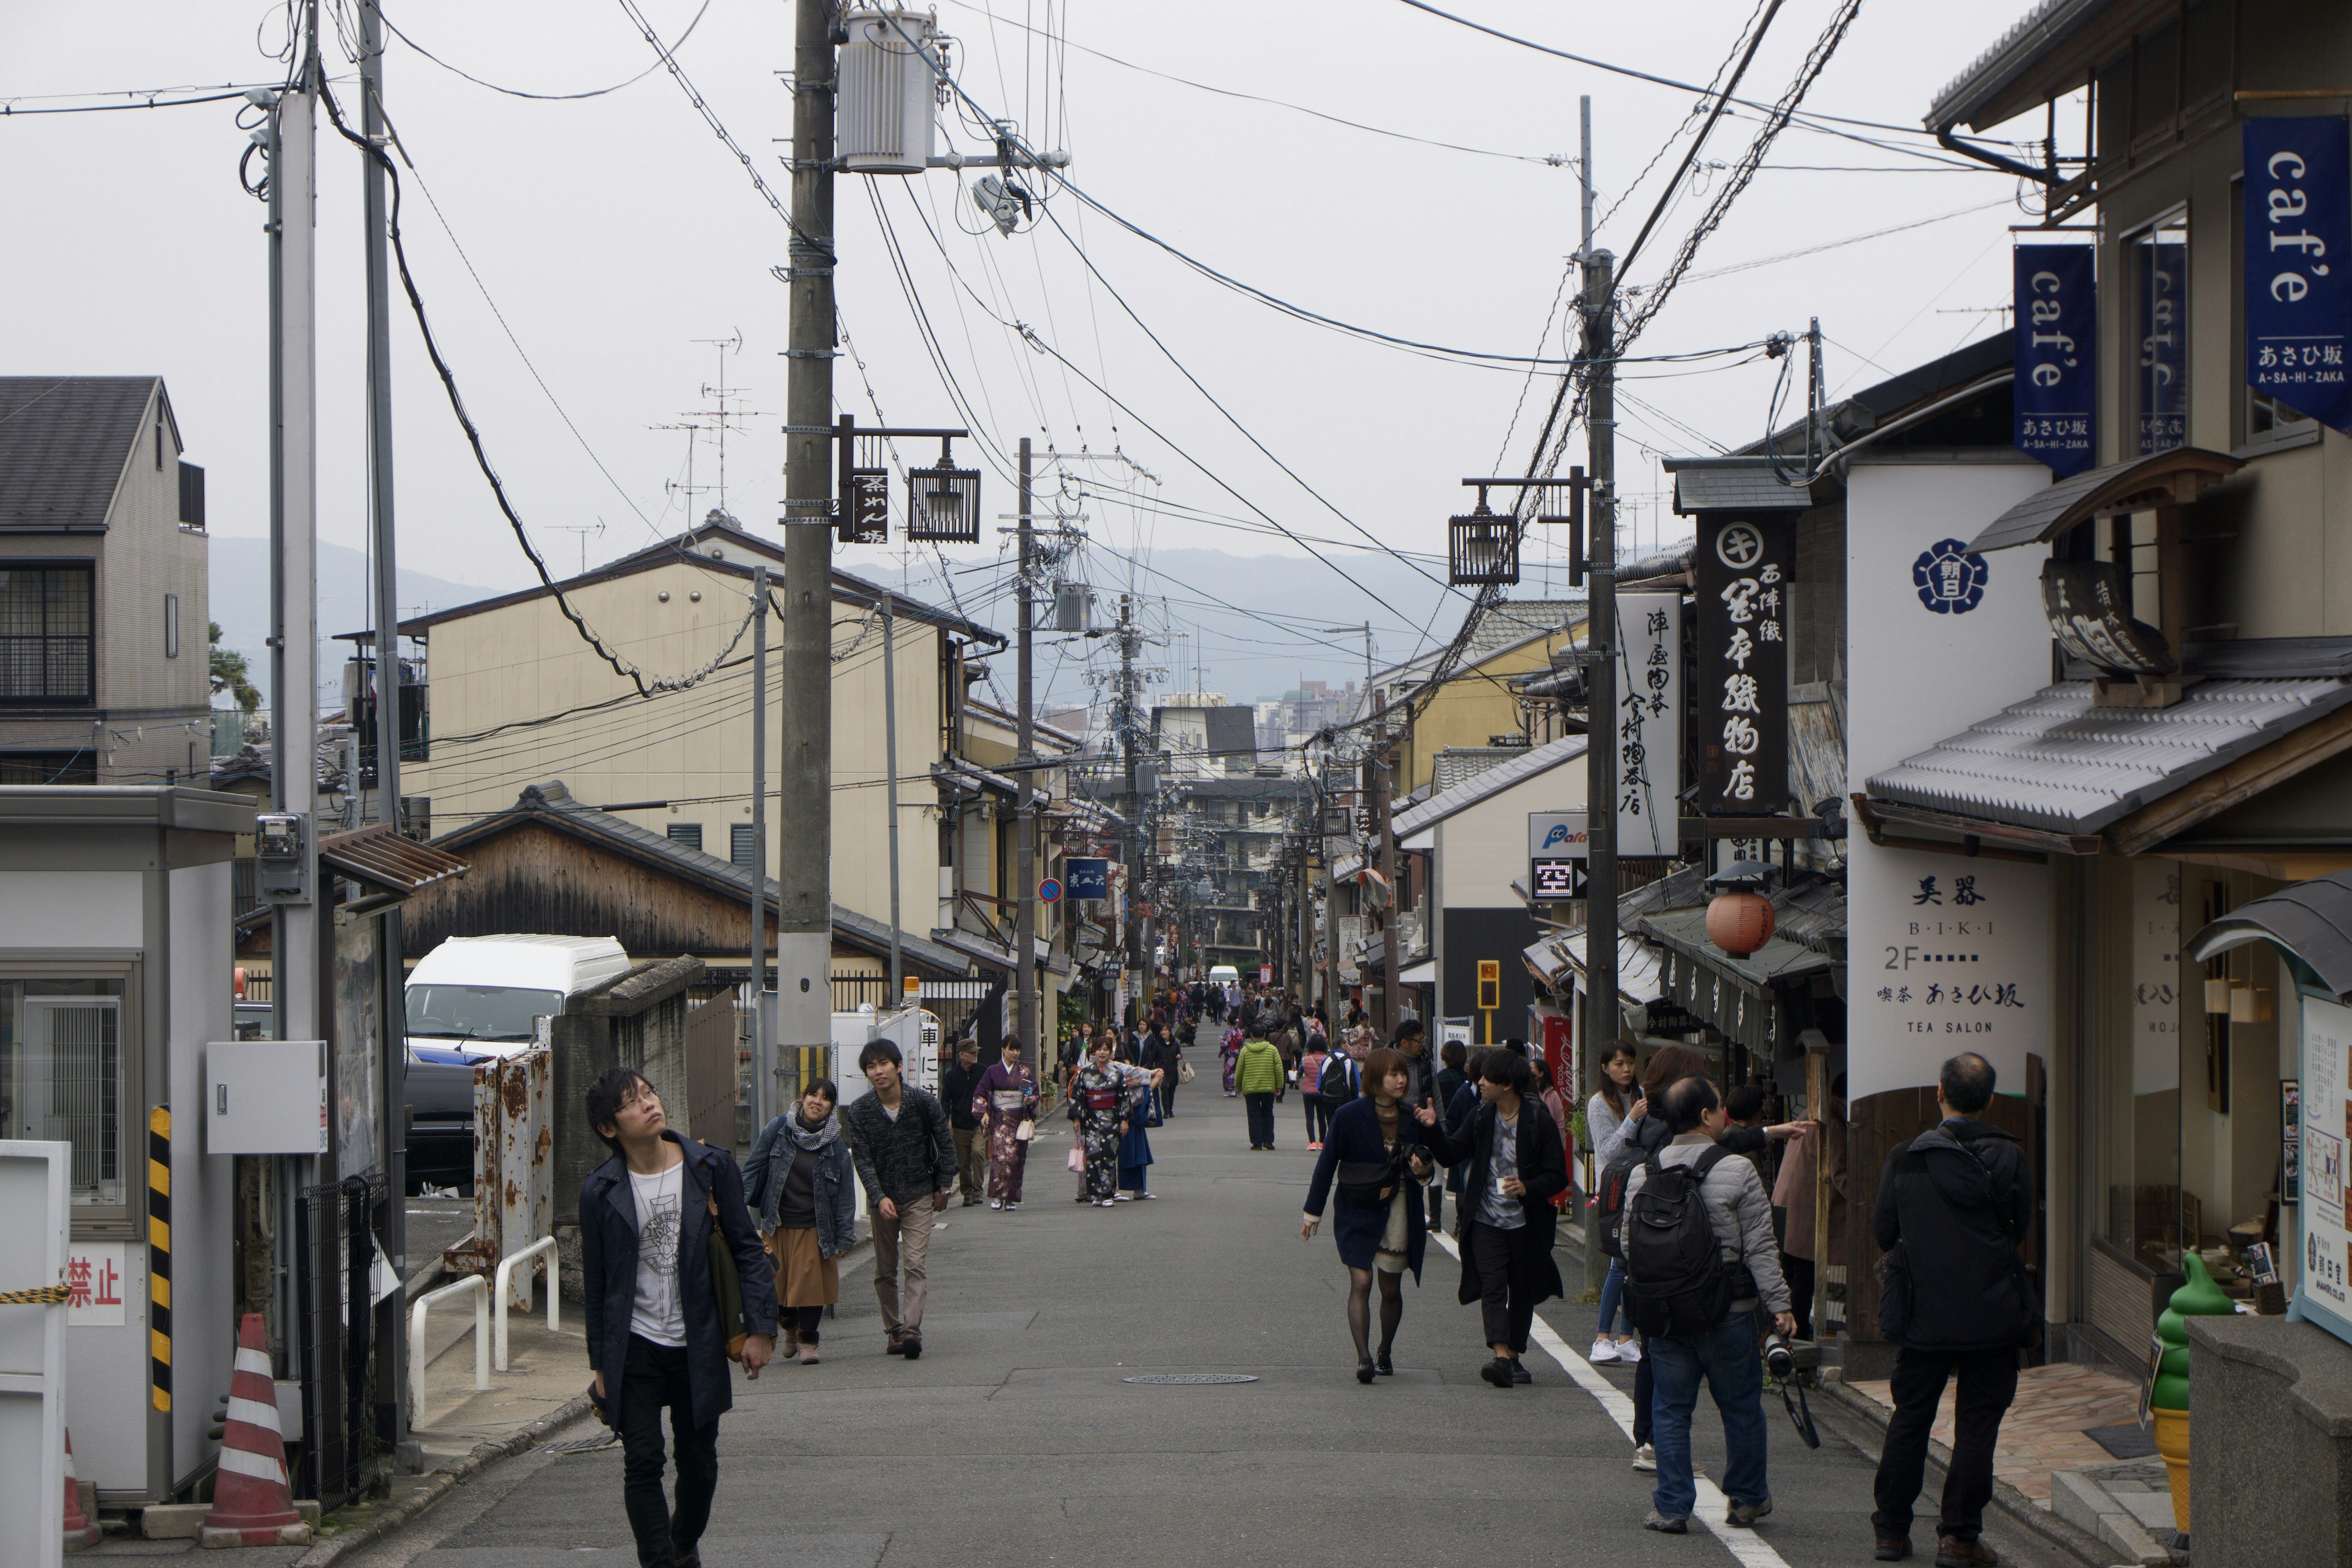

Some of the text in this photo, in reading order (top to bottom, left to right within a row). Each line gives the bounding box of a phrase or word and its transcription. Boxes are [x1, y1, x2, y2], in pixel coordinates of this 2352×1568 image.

[2258, 345, 2344, 367] あさひ坂
[2259, 371, 2344, 384] A-SA-HI-ZAKA
[2023, 419, 2088, 436] あさひ坂
[2024, 440, 2089, 449] A-SA-HI-ZAKA
[860, 477, 887, 544] 茶わん坂
[1941, 560, 1960, 597] 朝日
[1759, 564, 1783, 642] 西陣織
[1537, 861, 1570, 894] 空
[1912, 875, 1986, 906] 美器
[1884, 946, 1919, 971] 2F
[1877, 983, 2025, 1008] 喫茶 あさひ坂
[1648, 1015, 1693, 1029] 今村陶器
[1907, 1022, 1992, 1033] TEA SALON
